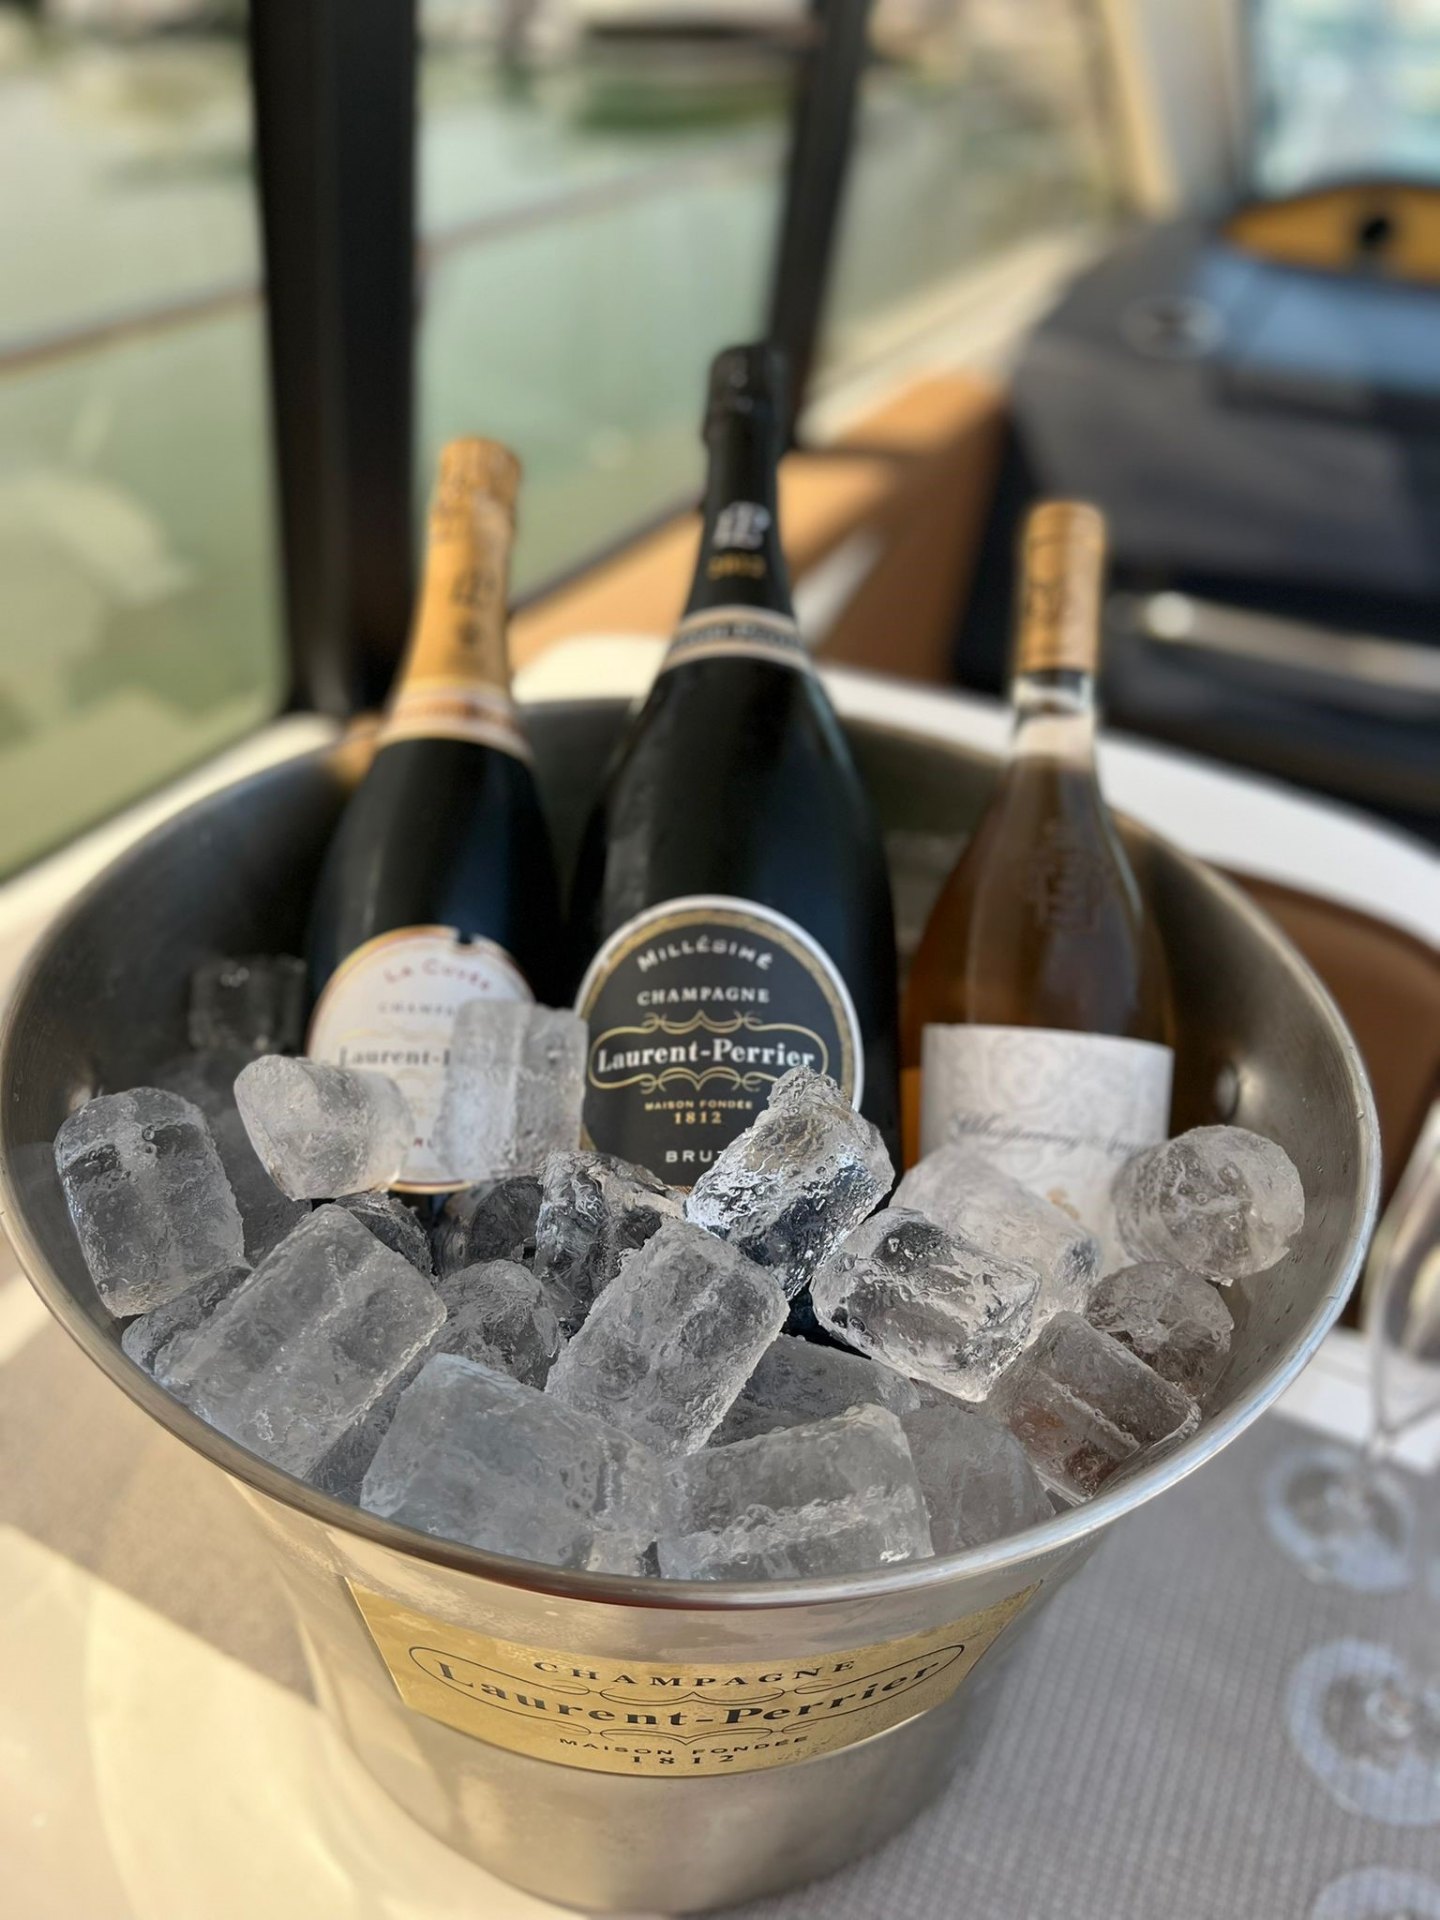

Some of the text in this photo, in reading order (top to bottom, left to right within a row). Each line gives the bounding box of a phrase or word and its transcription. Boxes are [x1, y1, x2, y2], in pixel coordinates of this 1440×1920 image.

[637, 986, 770, 1006] CHAMPAGNE
[597, 1037, 815, 1073] Laurent-Perrier
[644, 1101, 694, 1110] MAISON
[674, 1111, 722, 1125] 1812
[665, 1150, 722, 1163] BRU
[534, 1661, 855, 1686] CHAMPAGNE
[435, 1660, 939, 1726] Laurent-Perrier
[560, 1738, 673, 1755] MAISON
[633, 1755, 735, 1765] 1812
